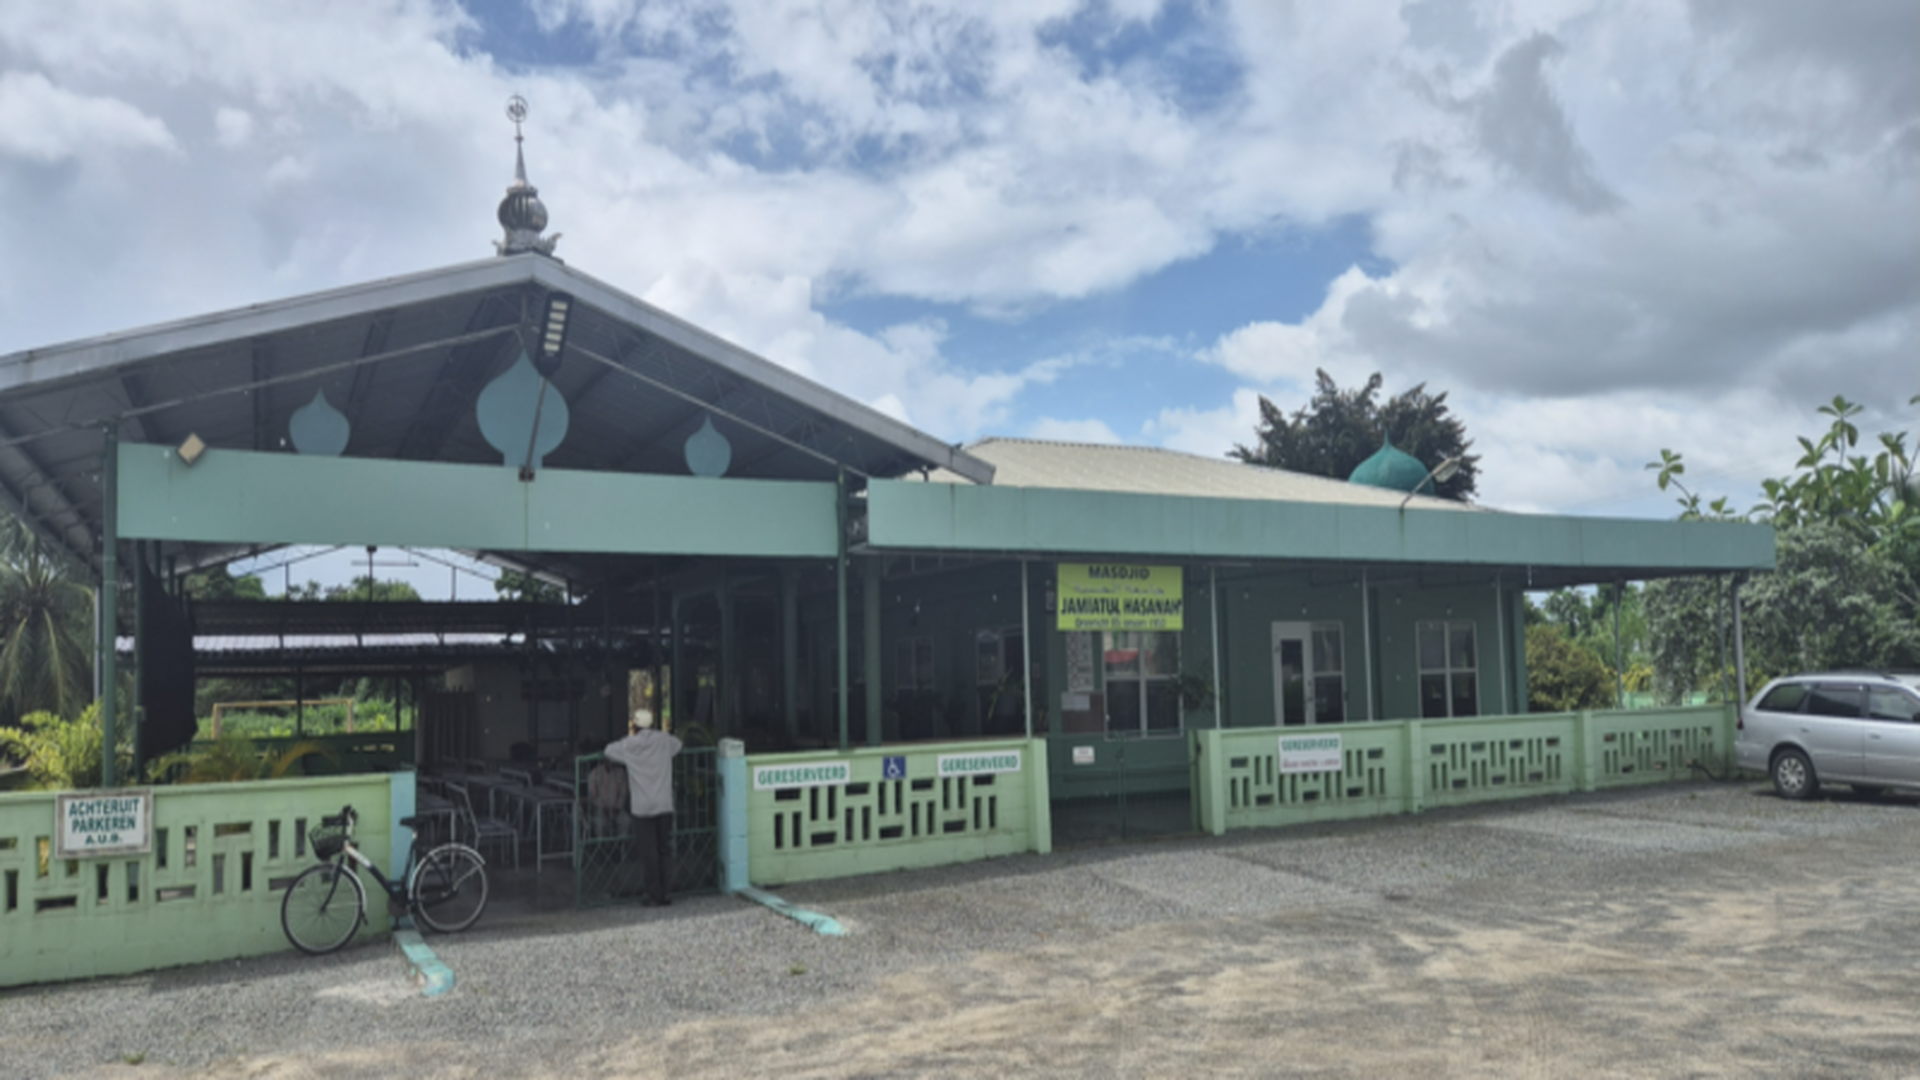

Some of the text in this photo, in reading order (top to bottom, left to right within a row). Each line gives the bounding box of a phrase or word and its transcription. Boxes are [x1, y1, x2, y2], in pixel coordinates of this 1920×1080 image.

[1061, 597, 1121, 616] JAMIATUL
[941, 755, 1018, 773] GERESERVEERD
[758, 766, 847, 786] GERESERVEERD
[69, 798, 140, 817] ACHTERUIT
[71, 816, 136, 834] PARKEREN
